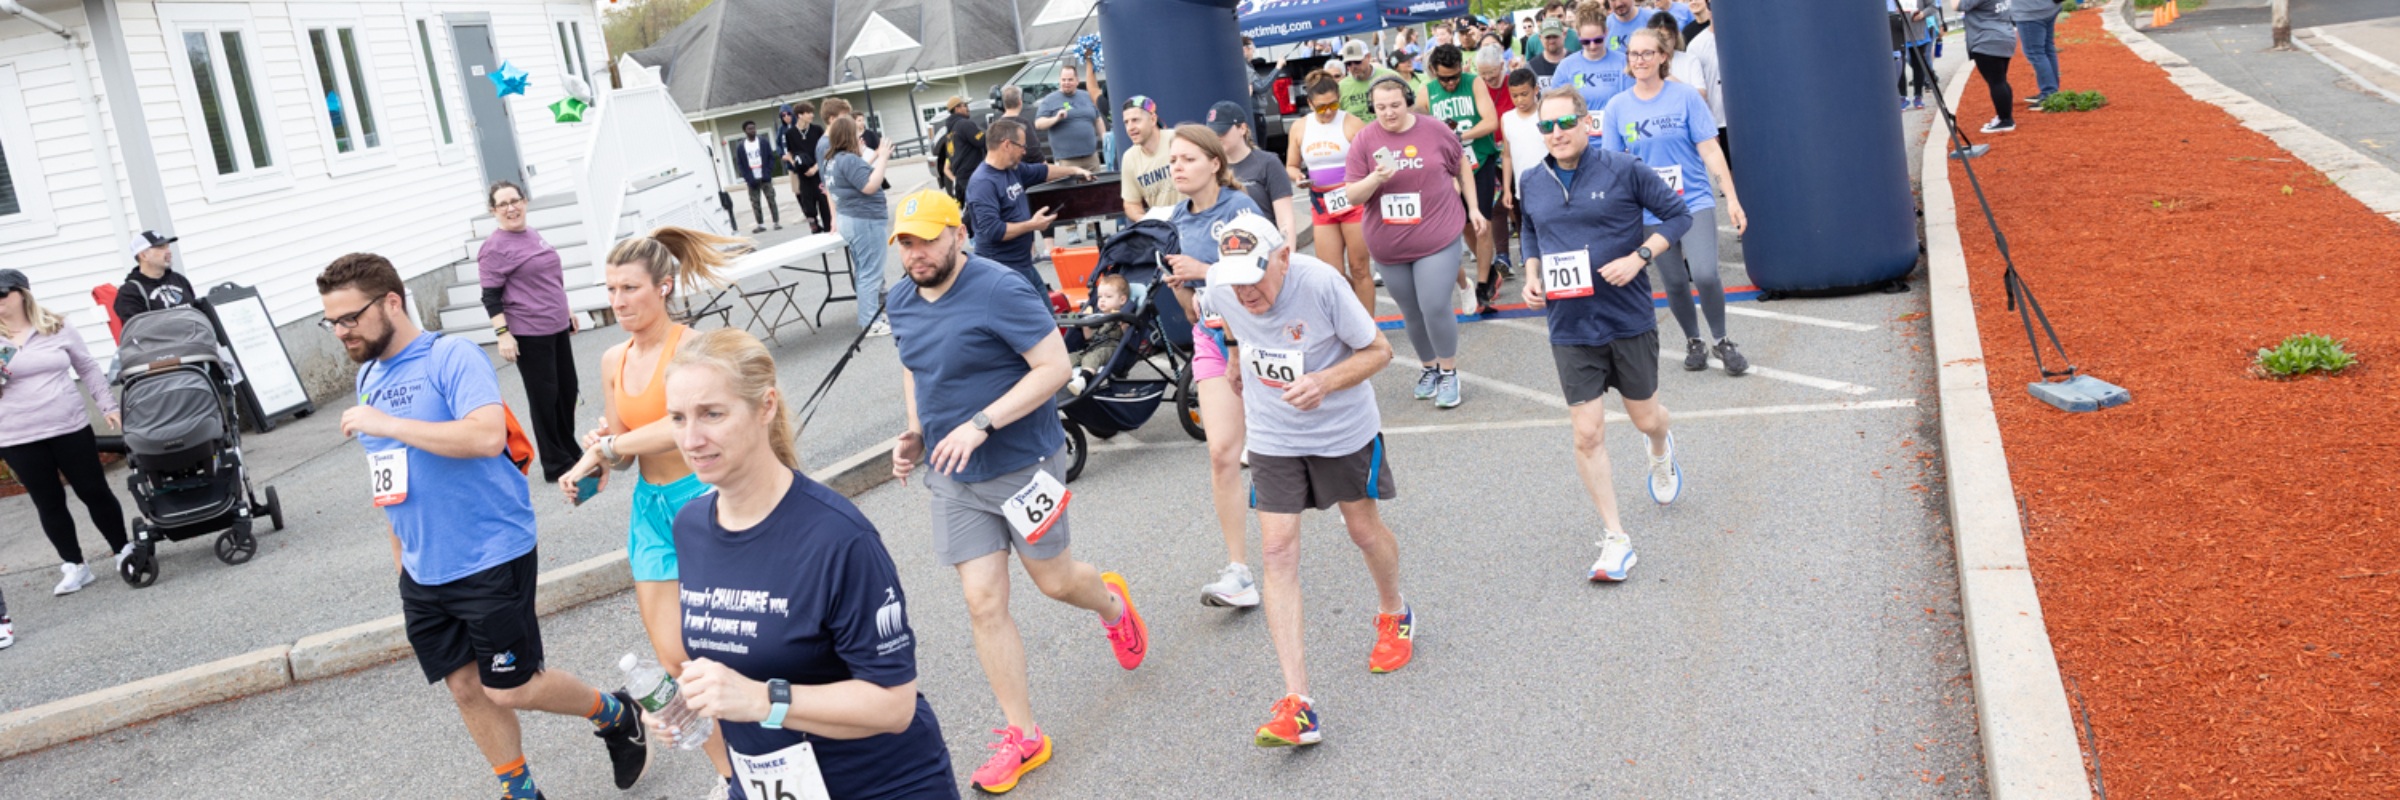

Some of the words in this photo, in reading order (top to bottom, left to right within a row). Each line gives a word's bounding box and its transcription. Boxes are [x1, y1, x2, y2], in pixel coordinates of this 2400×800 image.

[1573, 73, 1596, 89] 5K
[1432, 96, 1475, 120] BOSTON
[1625, 119, 1653, 143] 5K
[1652, 117, 1671, 126] LEAD
[1137, 164, 1172, 187] TRINIT
[1329, 195, 1351, 211] 20
[1387, 203, 1416, 217] 110
[1549, 266, 1581, 288] 701
[1252, 360, 1296, 383] 160
[382, 386, 407, 400] LEAD
[390, 394, 414, 408] WAY
[374, 468, 393, 493] 28
[1025, 492, 1054, 523] 63
[711, 587, 770, 613] CHALLENGE
[744, 757, 787, 773] YANKEE
[750, 779, 798, 800] 76
